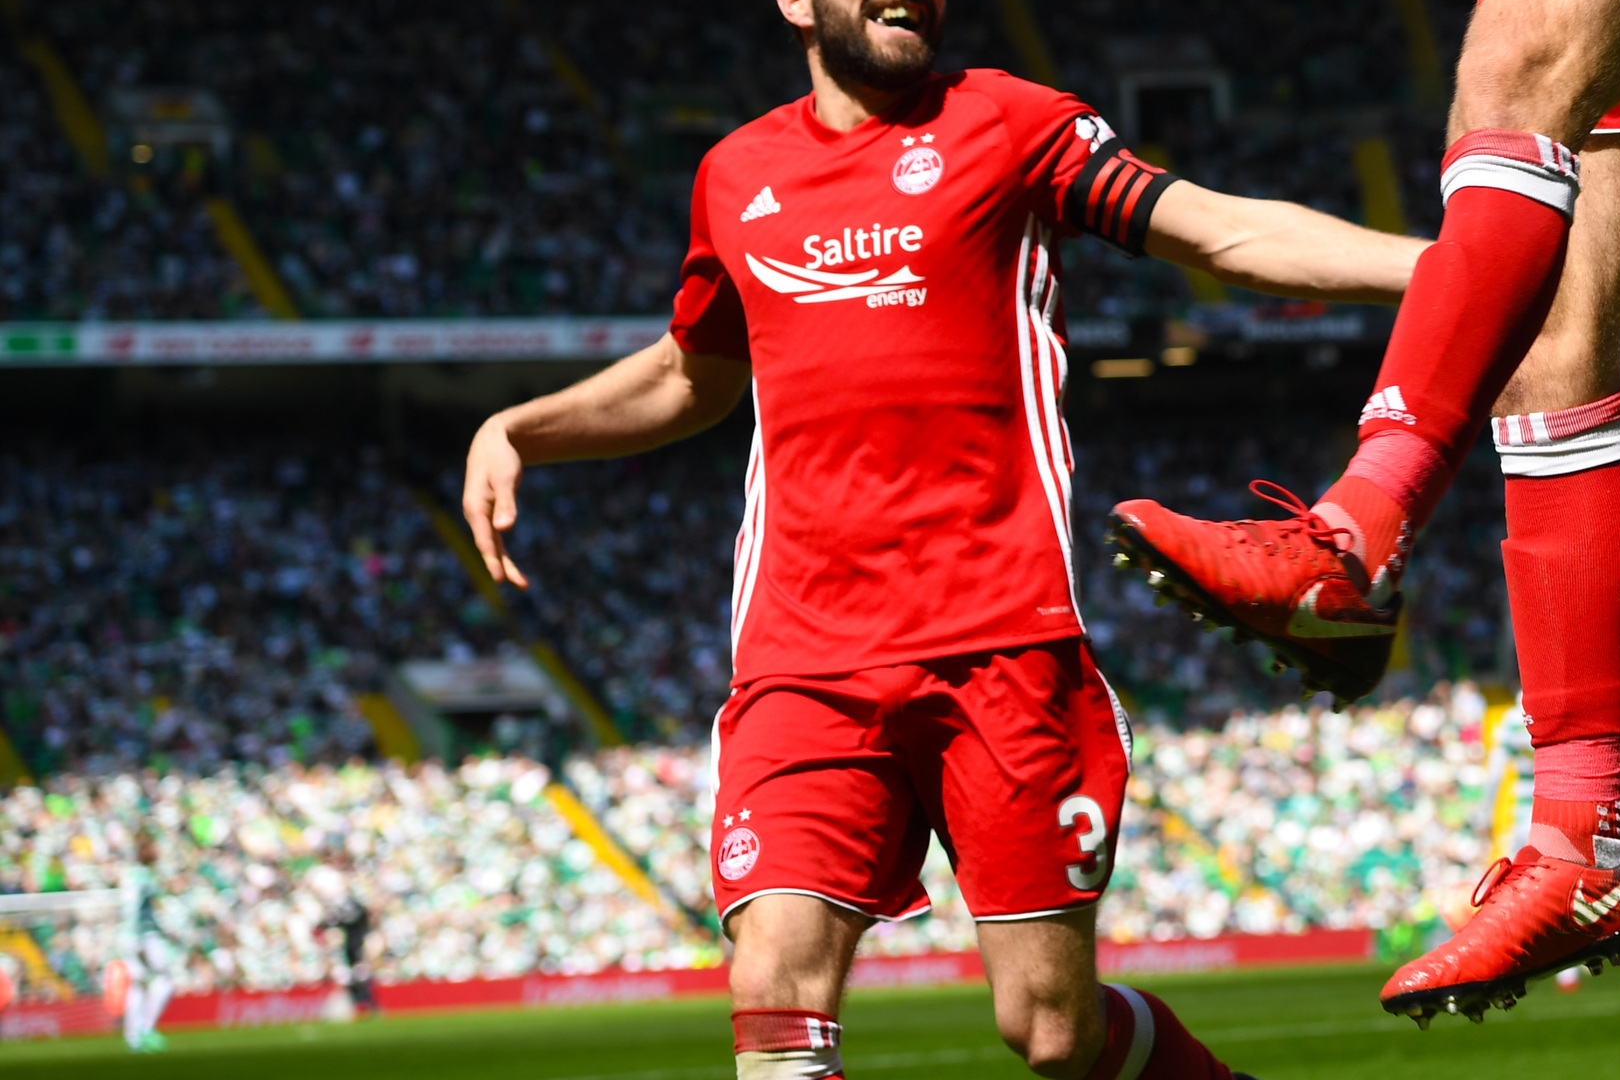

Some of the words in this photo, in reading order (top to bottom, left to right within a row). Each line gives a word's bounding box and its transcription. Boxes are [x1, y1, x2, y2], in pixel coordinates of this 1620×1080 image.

[803, 223, 923, 270] Saltire
[866, 287, 927, 308] energy
[1057, 794, 1107, 892] 3
